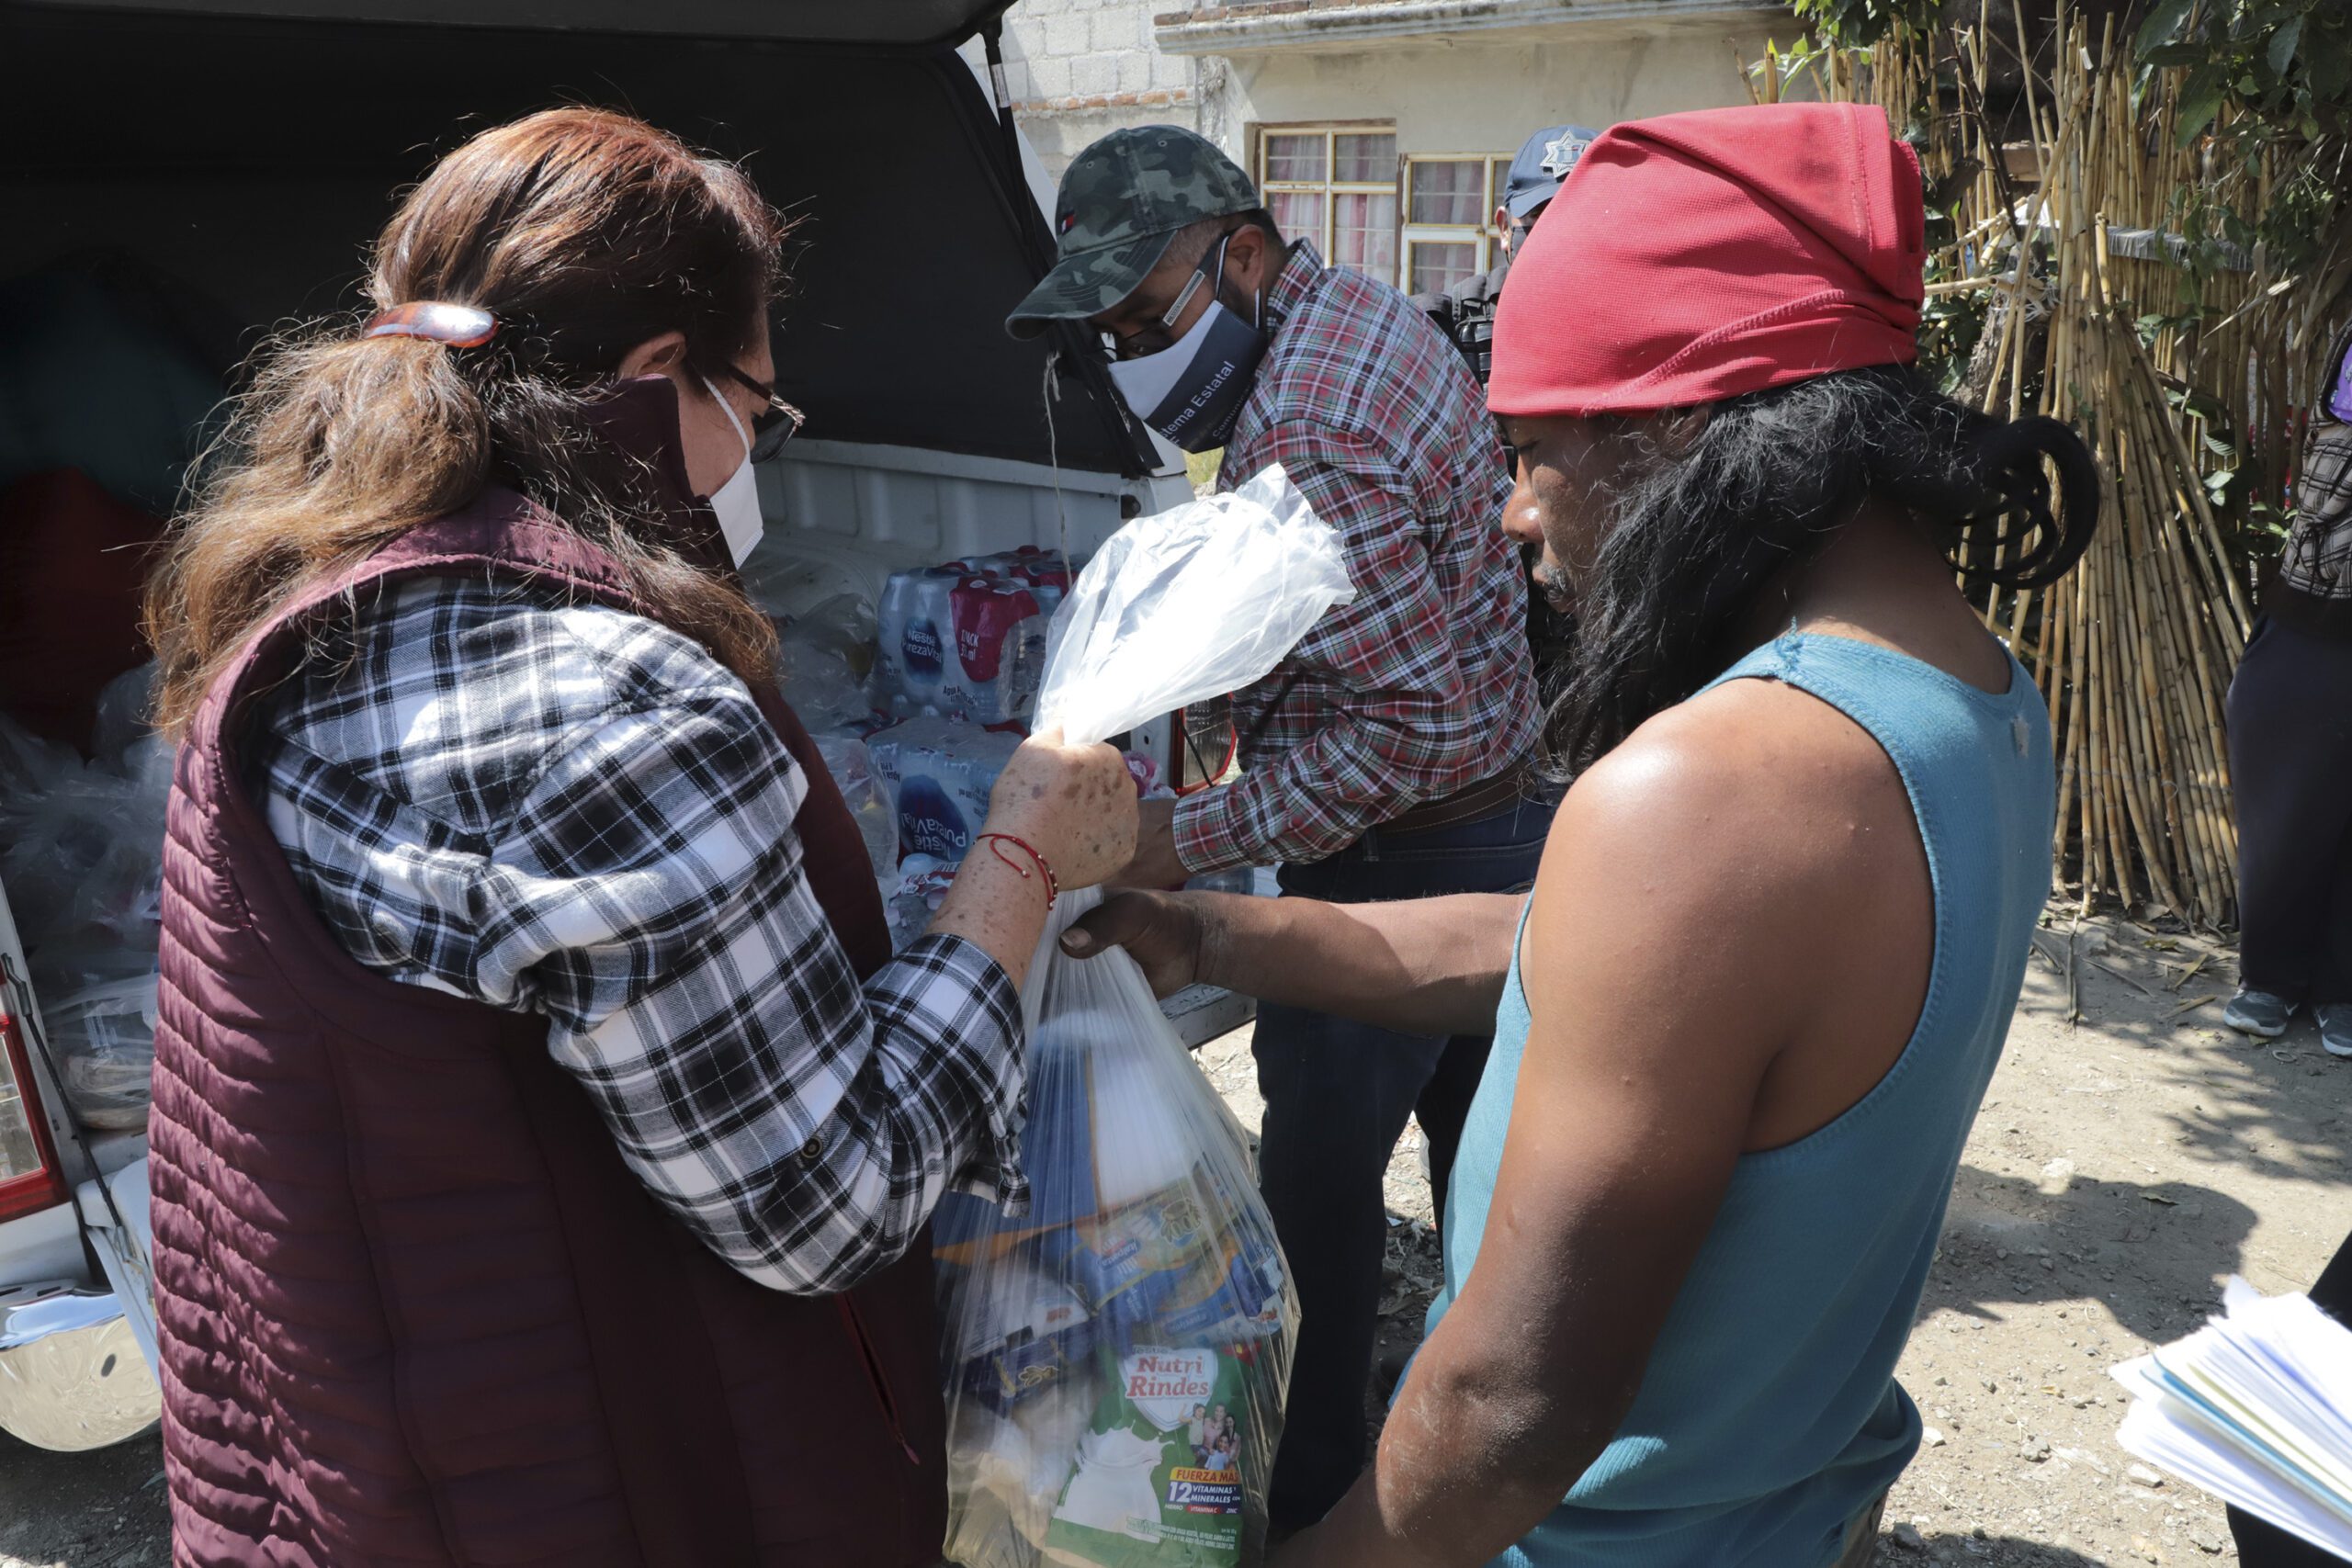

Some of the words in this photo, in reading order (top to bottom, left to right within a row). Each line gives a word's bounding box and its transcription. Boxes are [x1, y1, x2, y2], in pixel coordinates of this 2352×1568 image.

[1191, 360, 1236, 407] Estatal
[1136, 1355, 1203, 1375] Nutri
[1126, 1376, 1209, 1397] Rindes
[1176, 1470, 1217, 1482] FUERZA
[1169, 1481, 1193, 1503] 12
[1190, 1495, 1231, 1504] MINERALES
